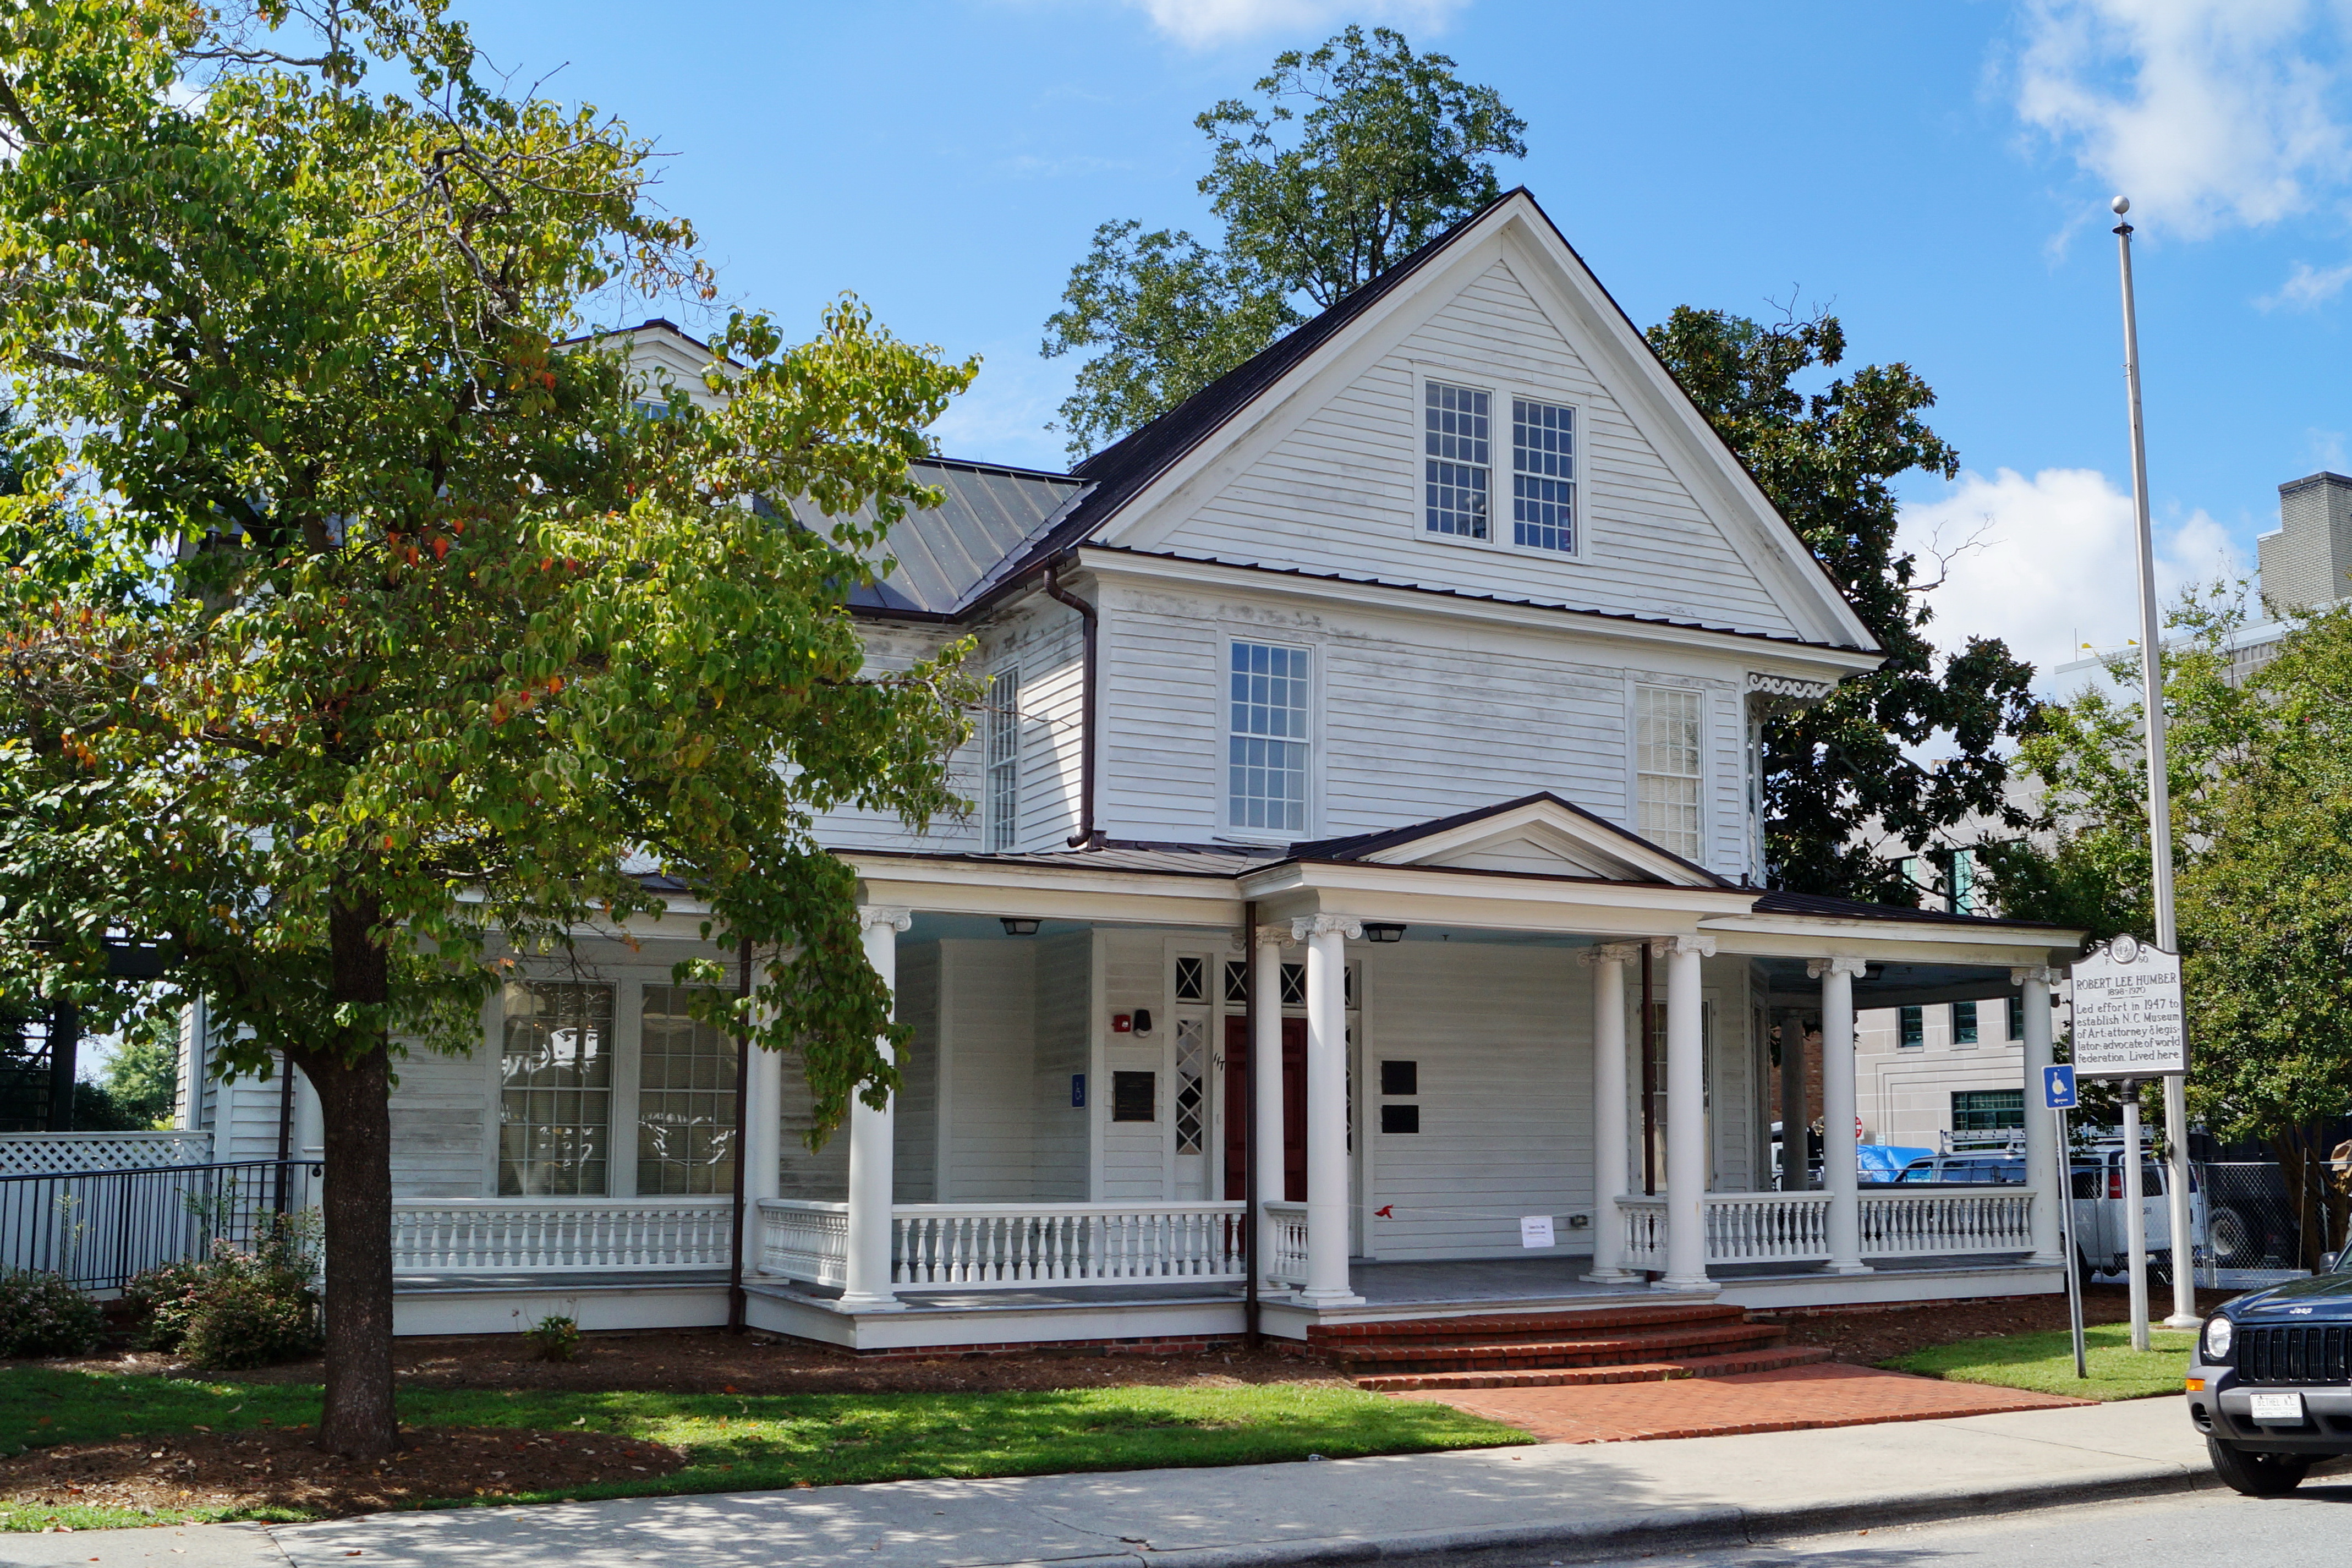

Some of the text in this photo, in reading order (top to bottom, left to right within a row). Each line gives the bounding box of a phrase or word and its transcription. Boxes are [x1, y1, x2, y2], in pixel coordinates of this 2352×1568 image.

[2076, 972, 2176, 990] ROBERT LEE HUMBER
[2108, 986, 2146, 996] 1898-1970
[2076, 999, 2179, 1014] Led effort in 1947 to
[2077, 1014, 2119, 1027] establish
[2144, 1012, 2180, 1023] Museum
[2077, 1029, 2087, 1039] of
[2107, 1027, 2147, 1038] attorney
[2149, 1026, 2155, 1035] &
[2156, 1024, 2180, 1036] legis-
[2103, 1039, 2142, 1050] advocate
[2144, 1038, 2154, 1048] of
[2155, 1036, 2180, 1046] world
[2078, 1049, 2181, 1063] federation. Lived here.
